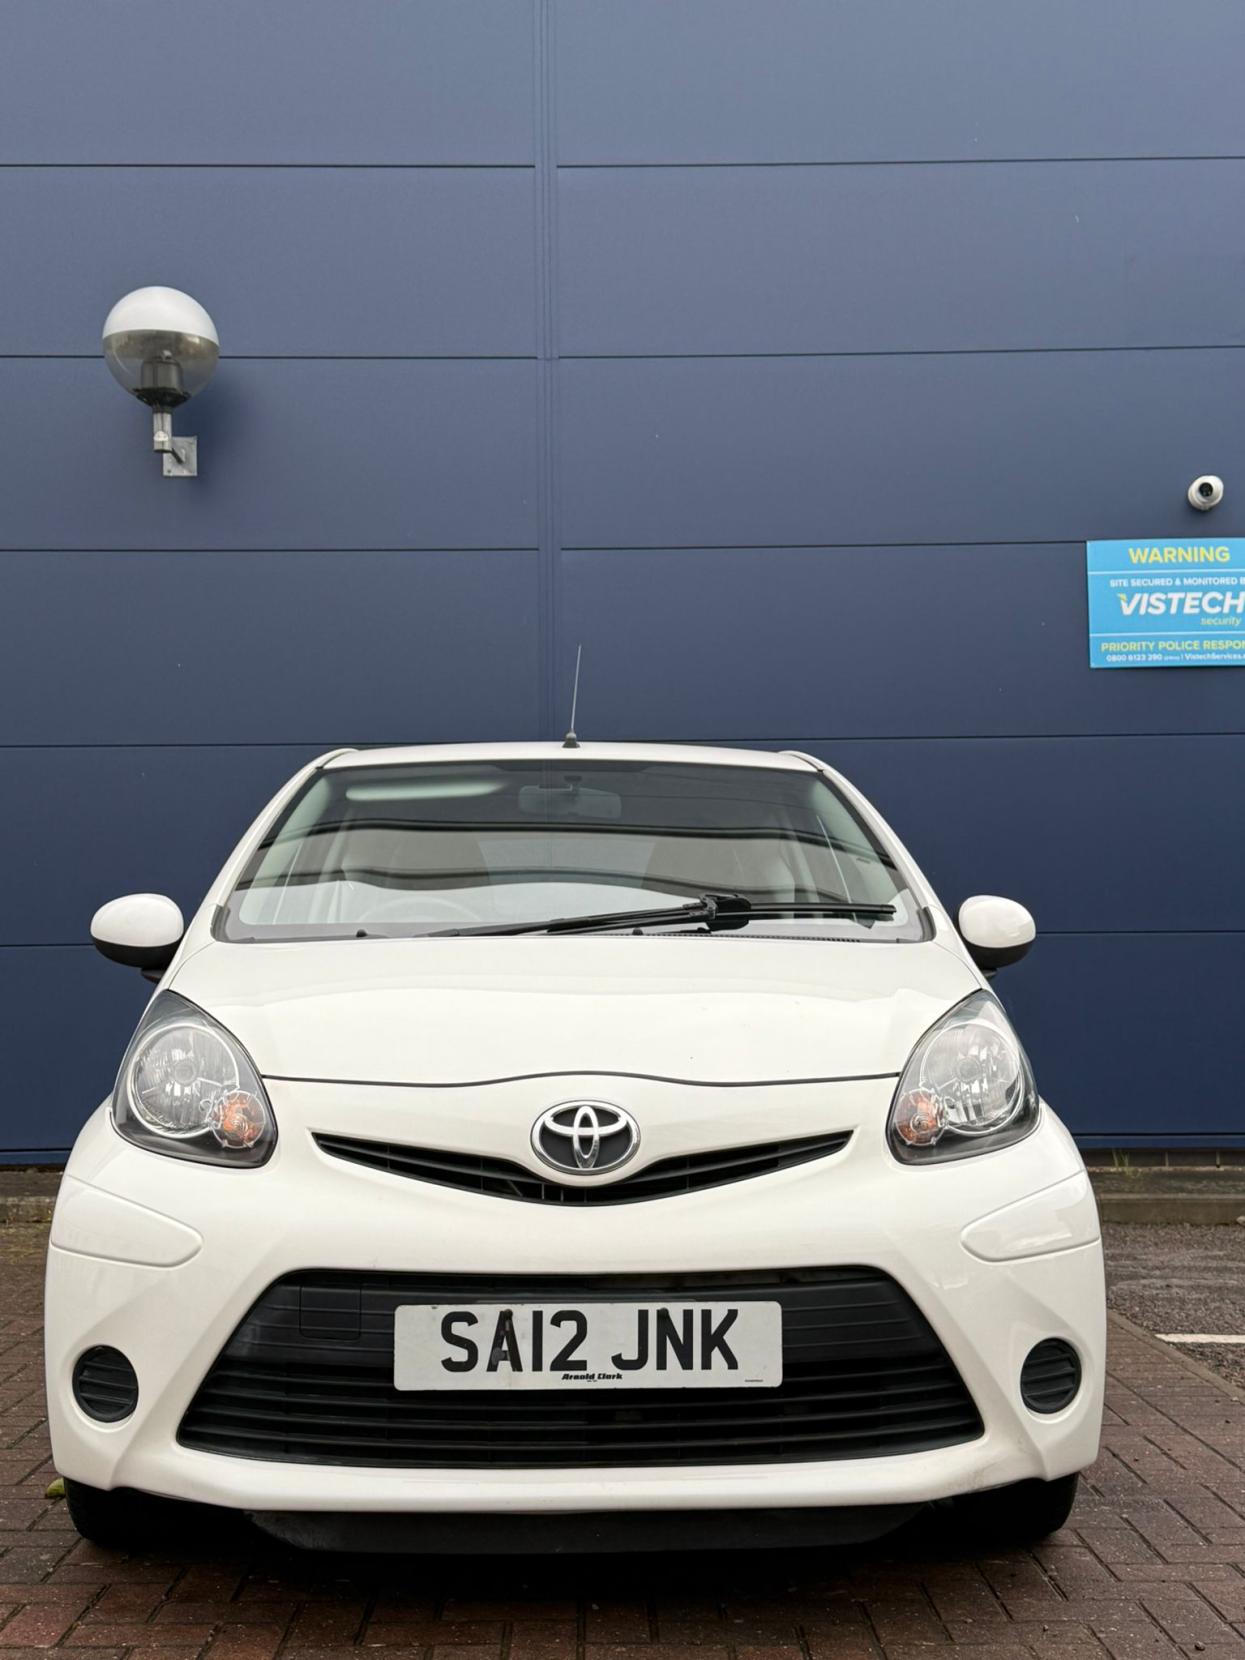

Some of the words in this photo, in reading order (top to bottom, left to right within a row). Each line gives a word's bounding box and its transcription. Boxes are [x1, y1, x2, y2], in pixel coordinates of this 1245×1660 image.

[1128, 546, 1232, 564] WARNING
[1109, 578, 1129, 588] SITE
[1130, 577, 1173, 587] SECURED
[1175, 577, 1181, 586] &
[1183, 576, 1238, 586] MONITORED
[1117, 591, 1245, 616] VISTECH
[1200, 616, 1242, 627] security
[1101, 640, 1156, 652] PRIORITY
[1158, 640, 1200, 651] POLICE
[441, 1310, 588, 1373] SA12
[611, 1308, 739, 1371] JNK
